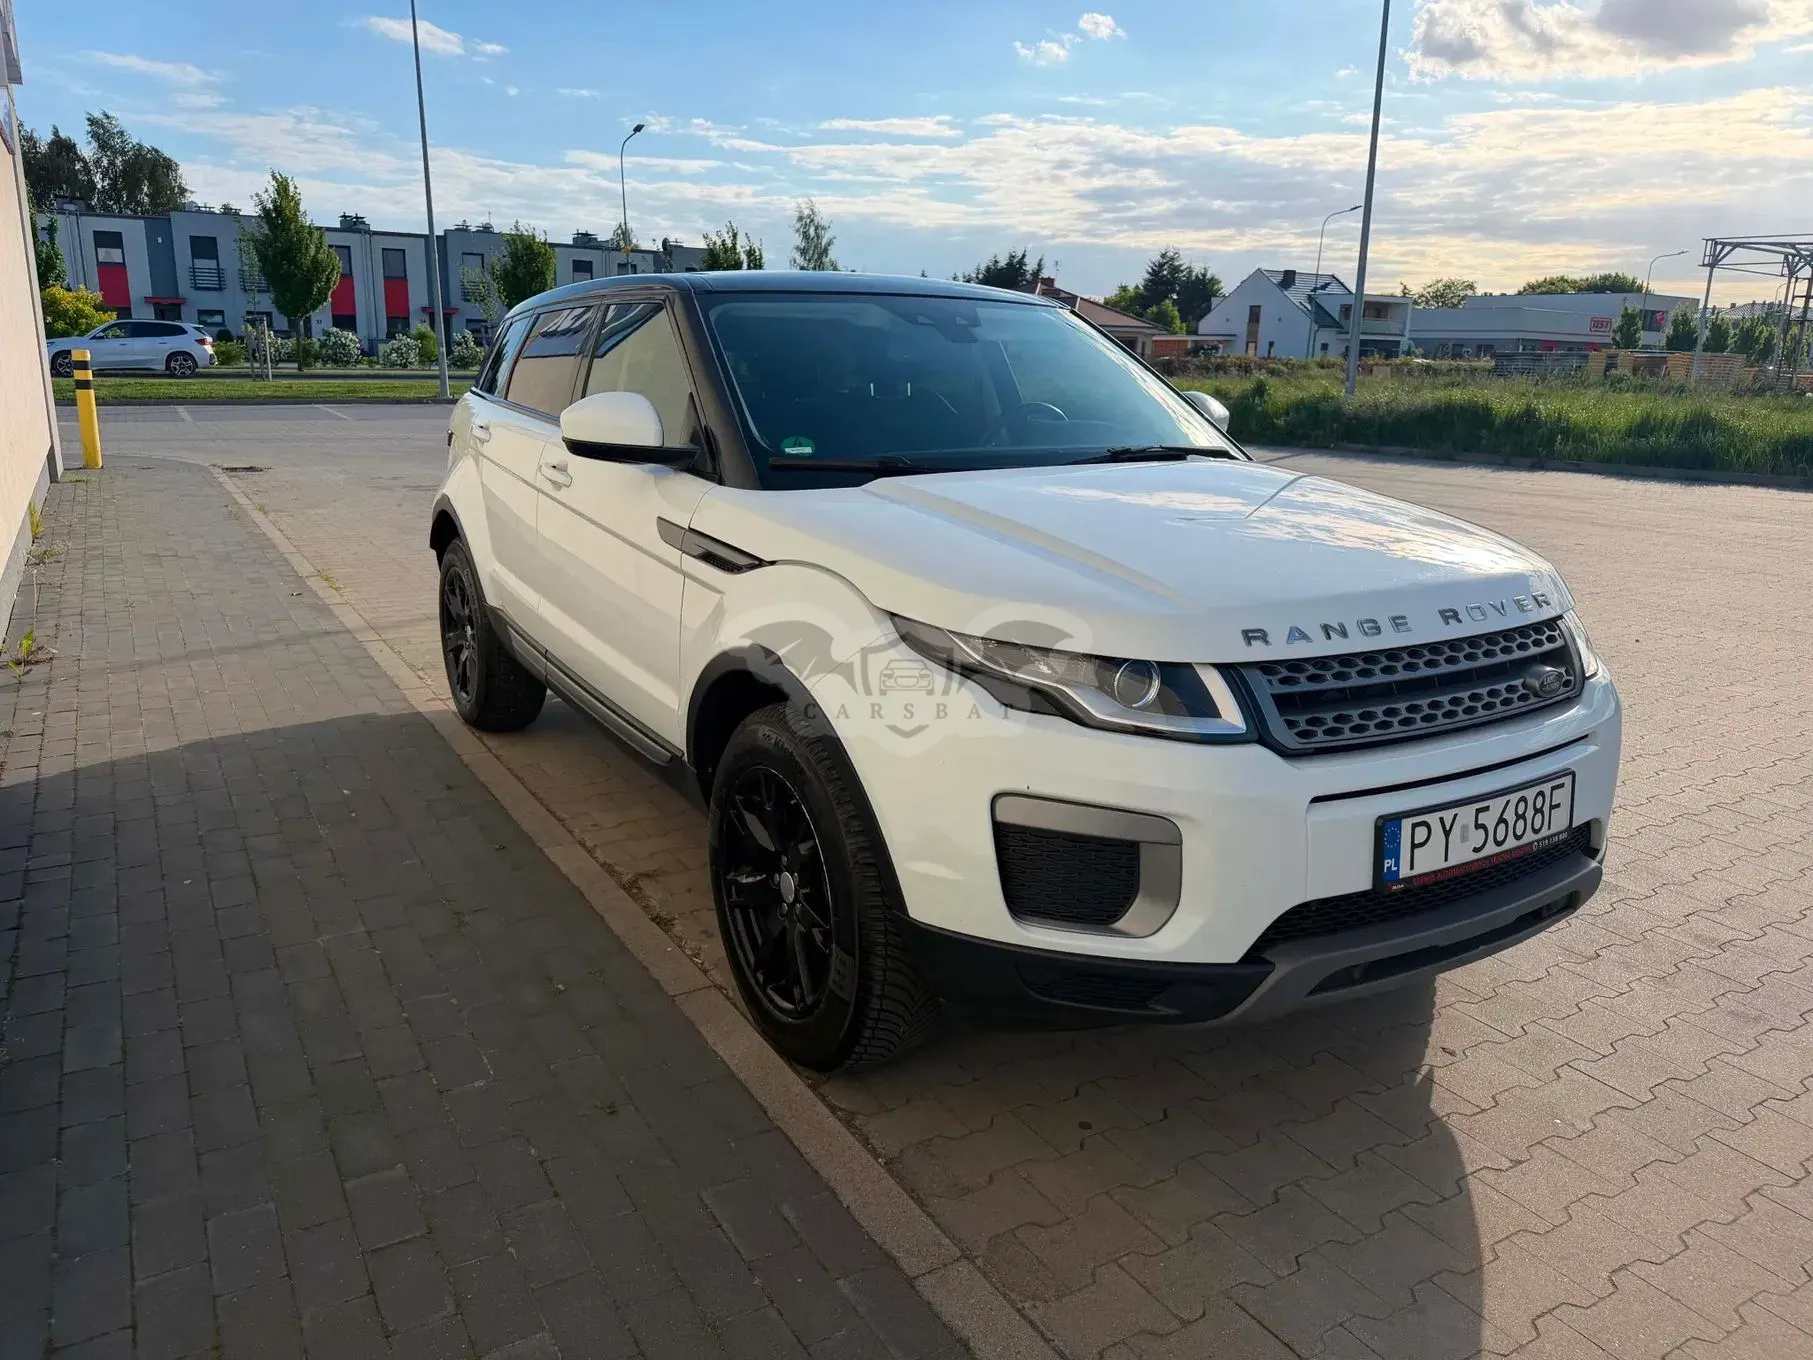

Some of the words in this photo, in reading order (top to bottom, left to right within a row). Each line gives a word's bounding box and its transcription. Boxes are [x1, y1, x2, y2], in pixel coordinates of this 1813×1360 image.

[1240, 614, 1412, 648] RANGE
[1437, 590, 1552, 626] ROVER
[1409, 813, 1459, 871] PY
[1472, 782, 1565, 853] 5688F
[1384, 858, 1398, 872] PL
